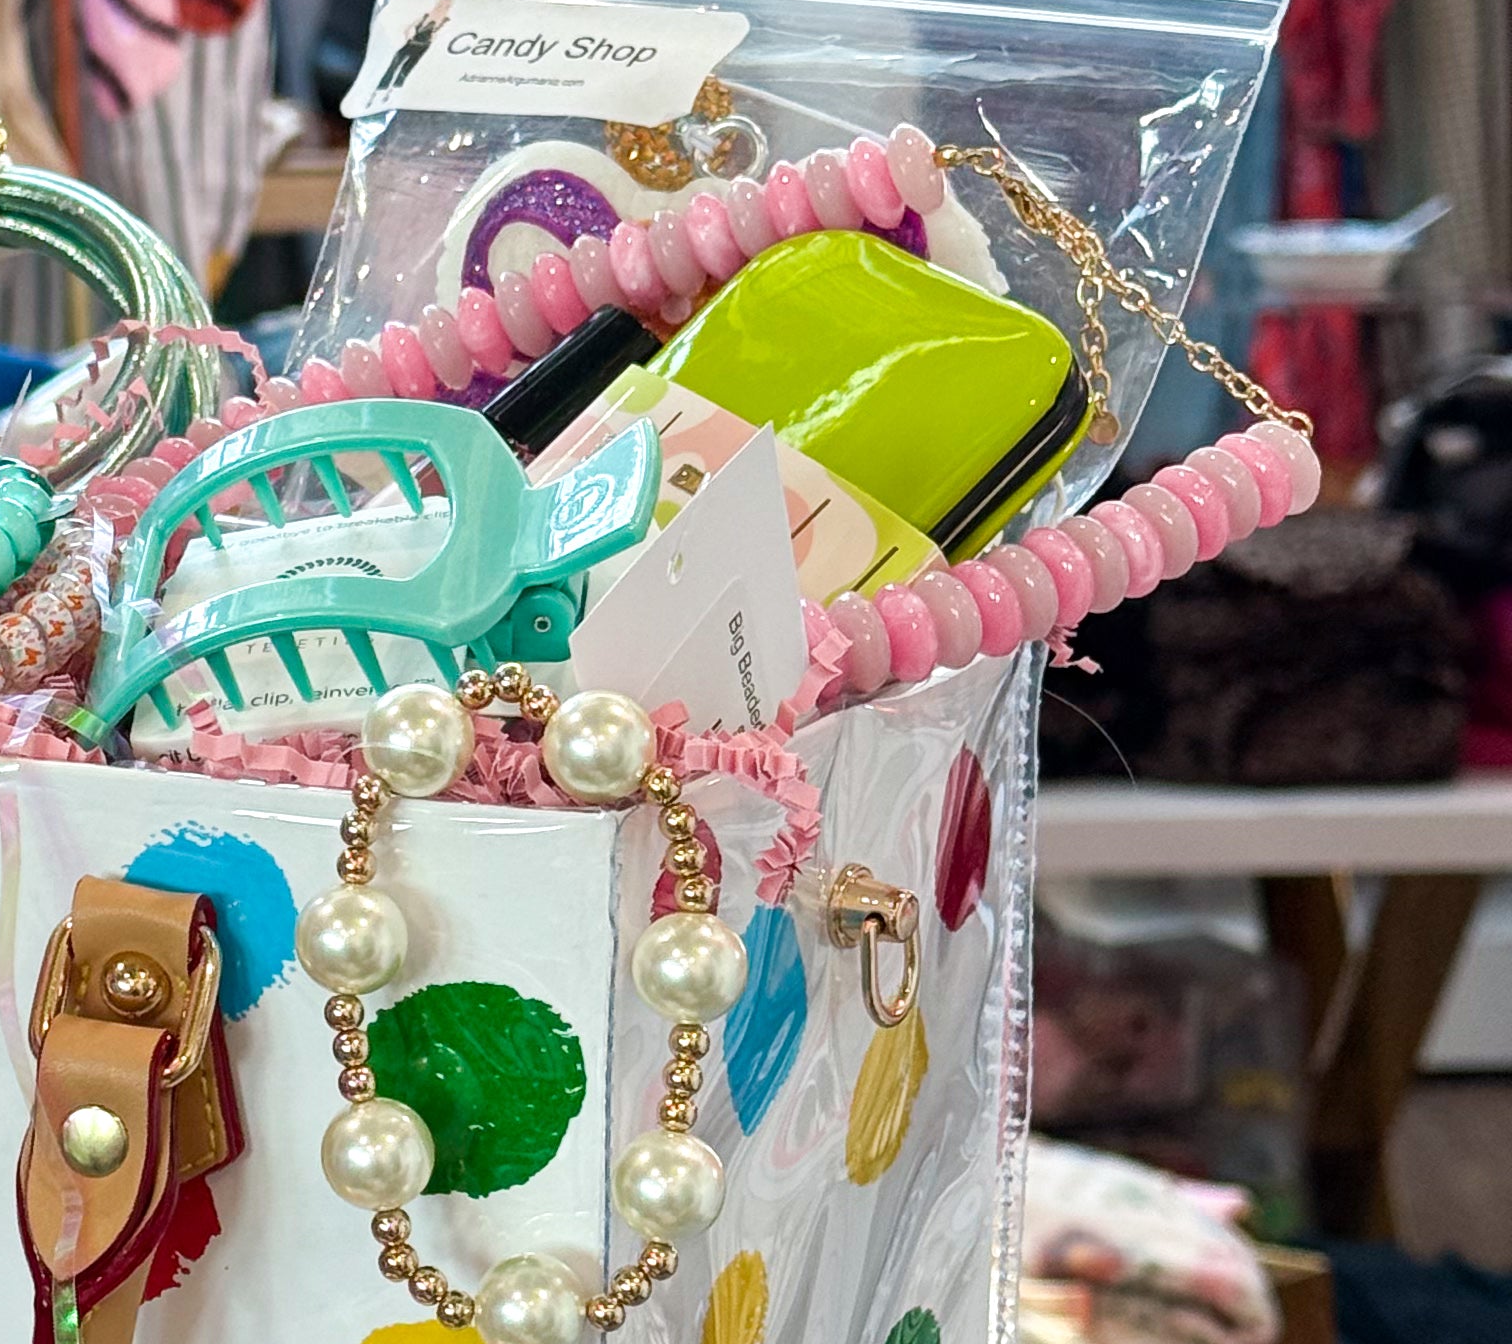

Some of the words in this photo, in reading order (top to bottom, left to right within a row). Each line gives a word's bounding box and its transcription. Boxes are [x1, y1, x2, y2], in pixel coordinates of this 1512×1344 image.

[447, 32, 558, 64] Candy
[565, 36, 658, 67] Shop
[728, 610, 745, 657] Big
[250, 690, 294, 708] clip,
